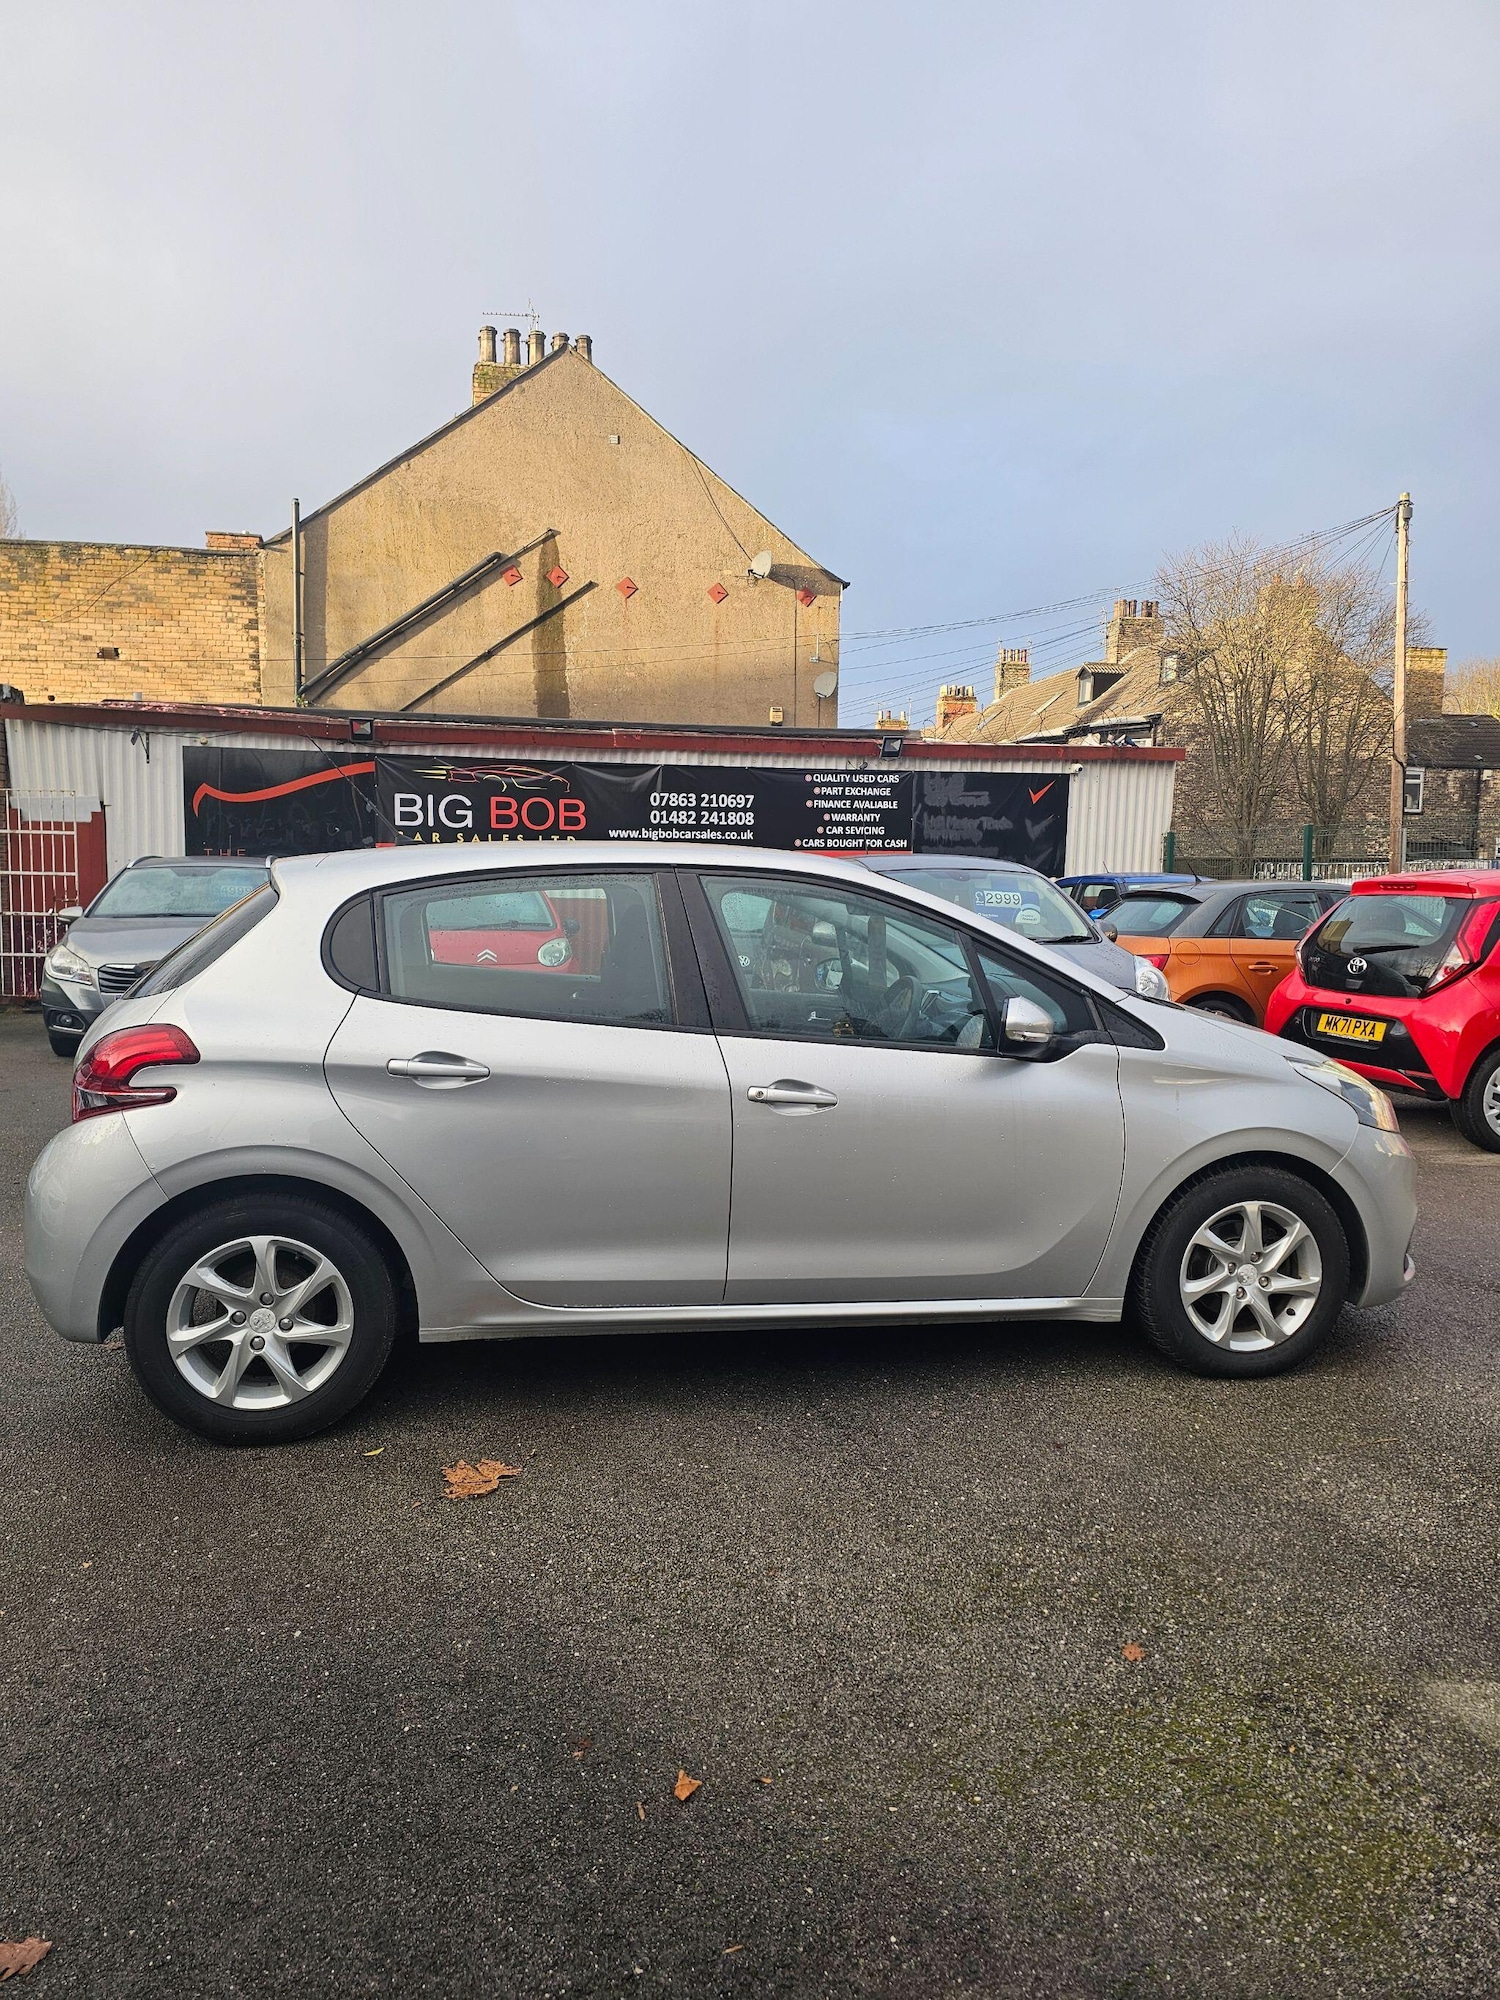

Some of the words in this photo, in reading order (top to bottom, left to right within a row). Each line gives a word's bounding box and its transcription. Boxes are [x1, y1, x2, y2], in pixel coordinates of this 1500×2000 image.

[813, 774, 851, 784] QUALITY
[852, 775, 876, 784] USED
[876, 775, 900, 784] CARS
[821, 787, 843, 796] PART
[845, 787, 892, 796] EXCHANGE
[649, 792, 697, 807] 07863
[700, 793, 755, 809] 210697
[813, 800, 852, 809] FINANCE
[852, 801, 898, 810] AVALIABLE
[394, 793, 473, 828] BIG
[490, 796, 586, 830] BOB
[650, 809, 697, 825] 01482
[700, 811, 755, 826] 241808
[831, 813, 881, 822] WARRANTY
[608, 827, 754, 841] www.bigbobcarsales.co.uk
[825, 826, 844, 835] CAR
[845, 826, 885, 836] SEVICING
[397, 831, 441, 843] AR
[802, 838, 825, 848] CARS
[827, 838, 864, 848] BOUGHT
[865, 838, 883, 848] FOR
[884, 839, 907, 848] CASH
